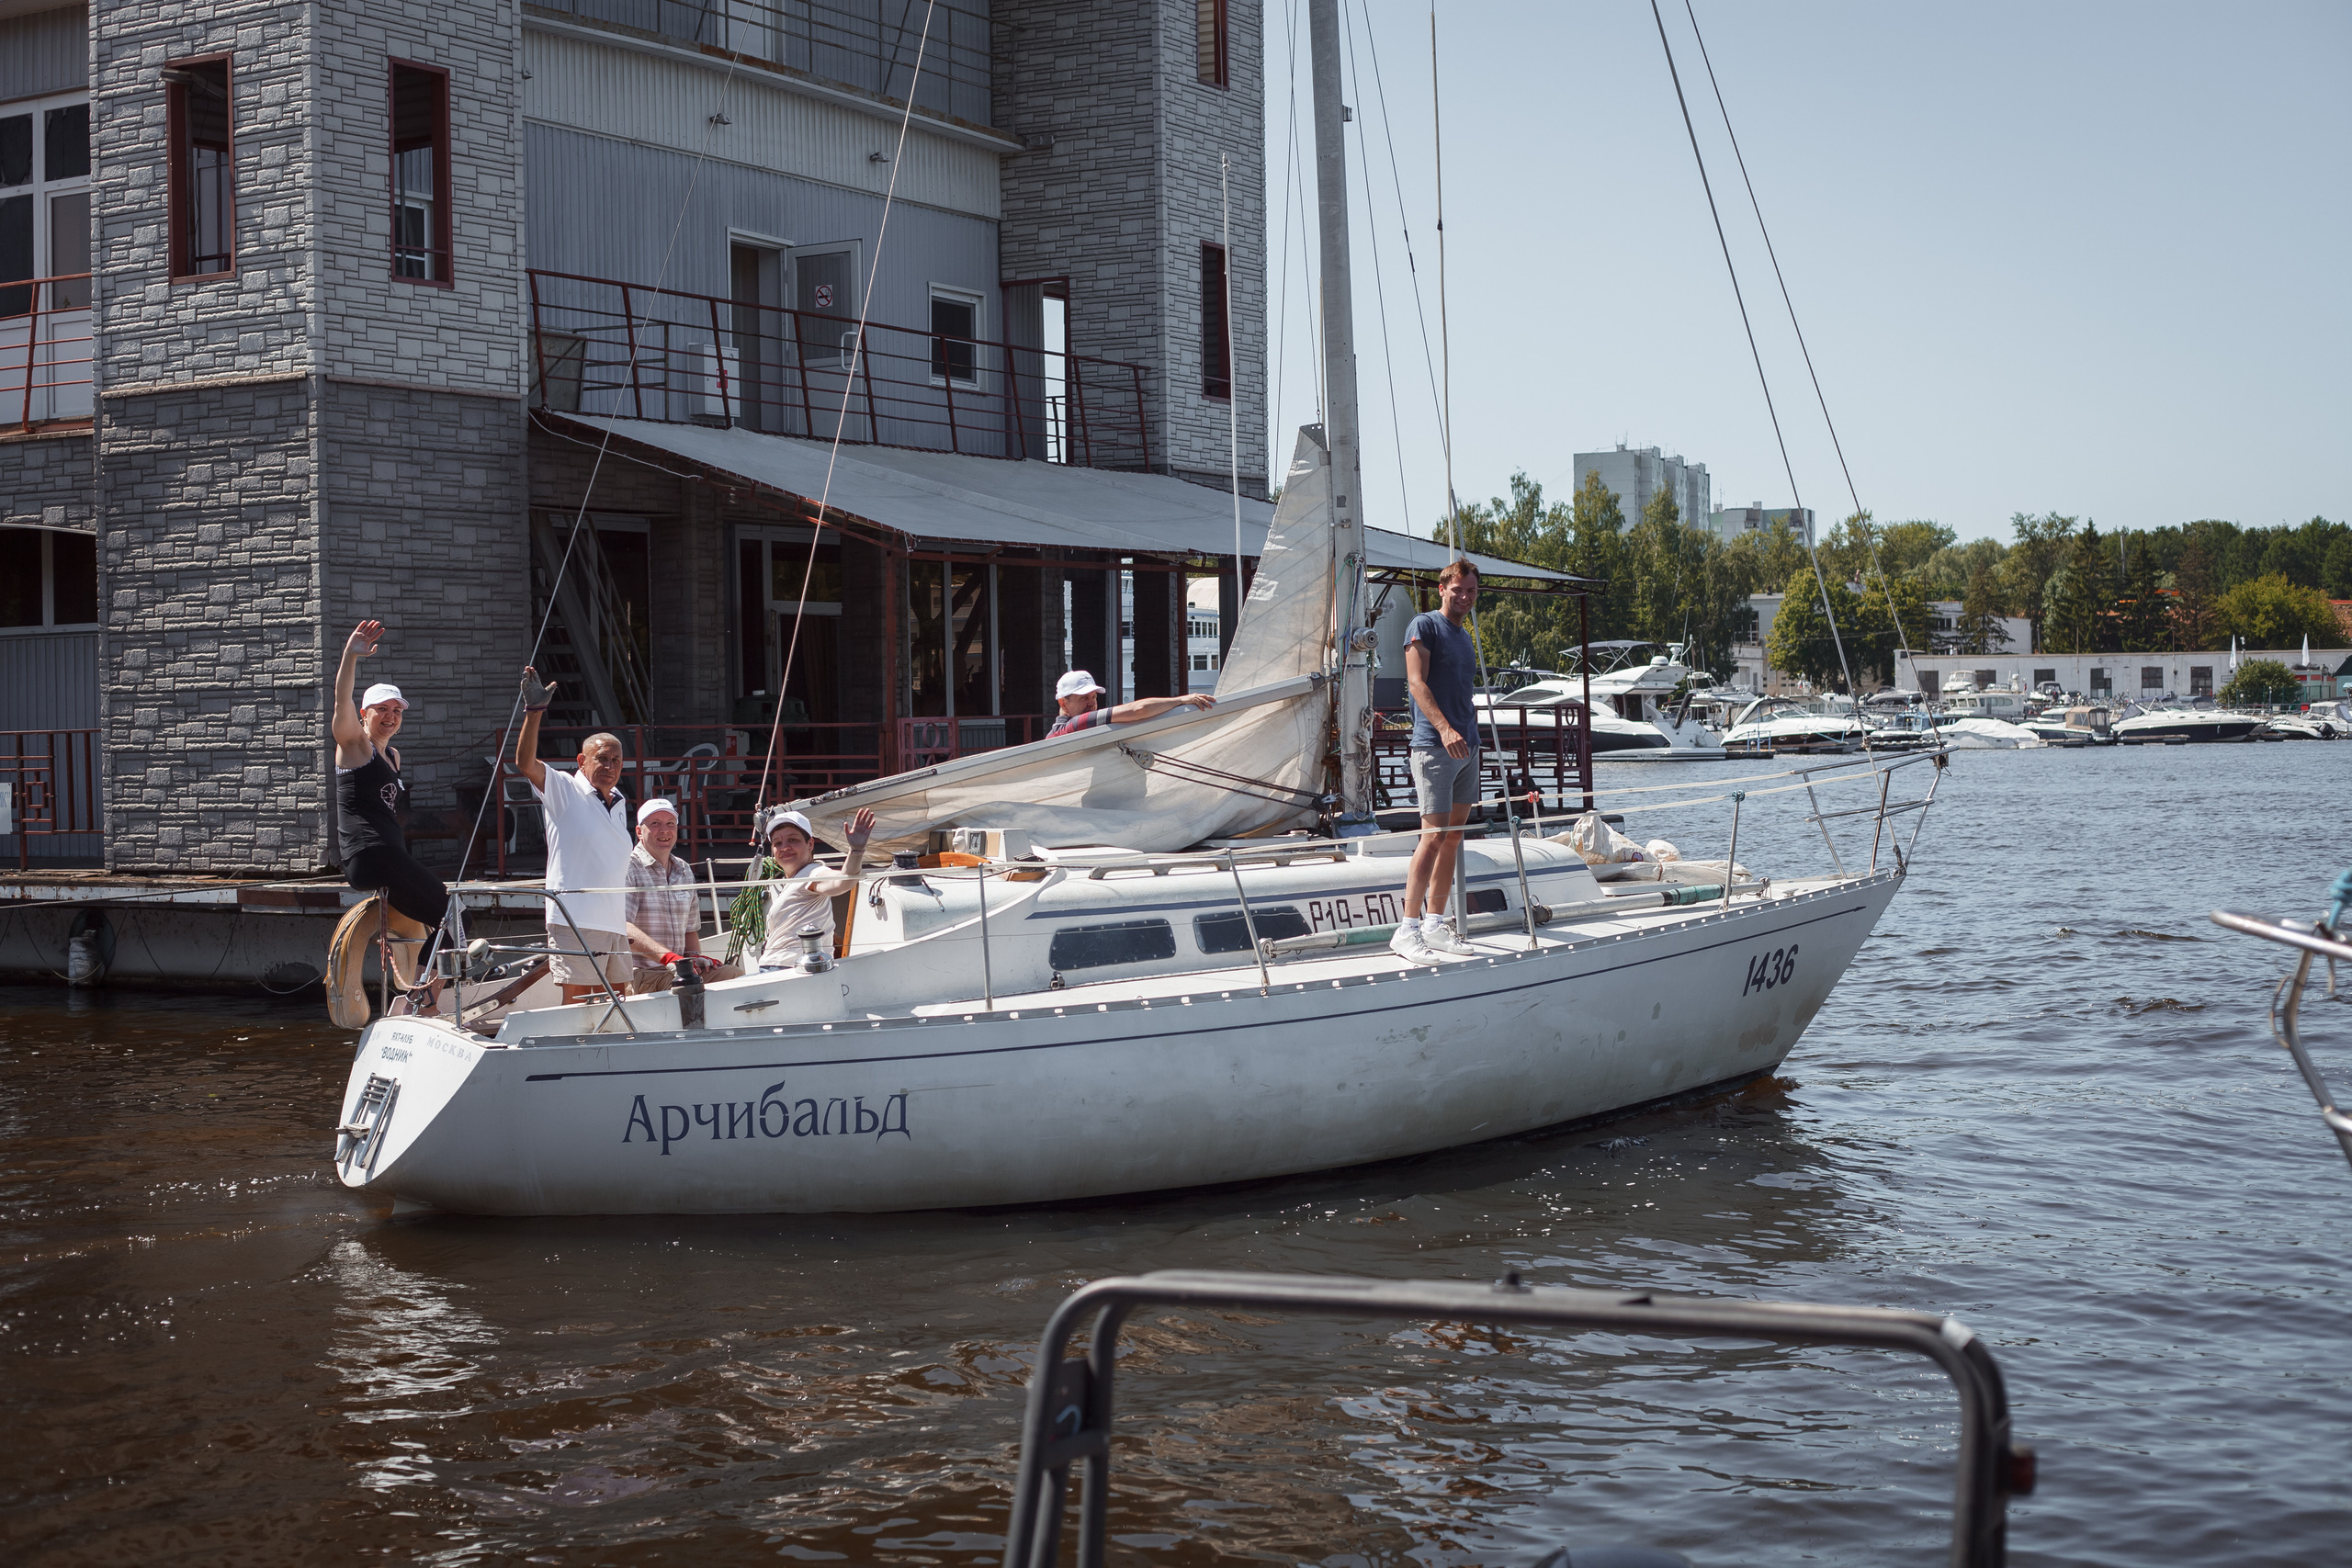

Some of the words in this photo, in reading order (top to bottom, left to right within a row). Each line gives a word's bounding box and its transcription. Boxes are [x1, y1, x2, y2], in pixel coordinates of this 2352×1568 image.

[1742, 943, 1799, 998] 1436
[426, 1036, 472, 1063] МОСКВА
[621, 1079, 911, 1156] Арчибальд
